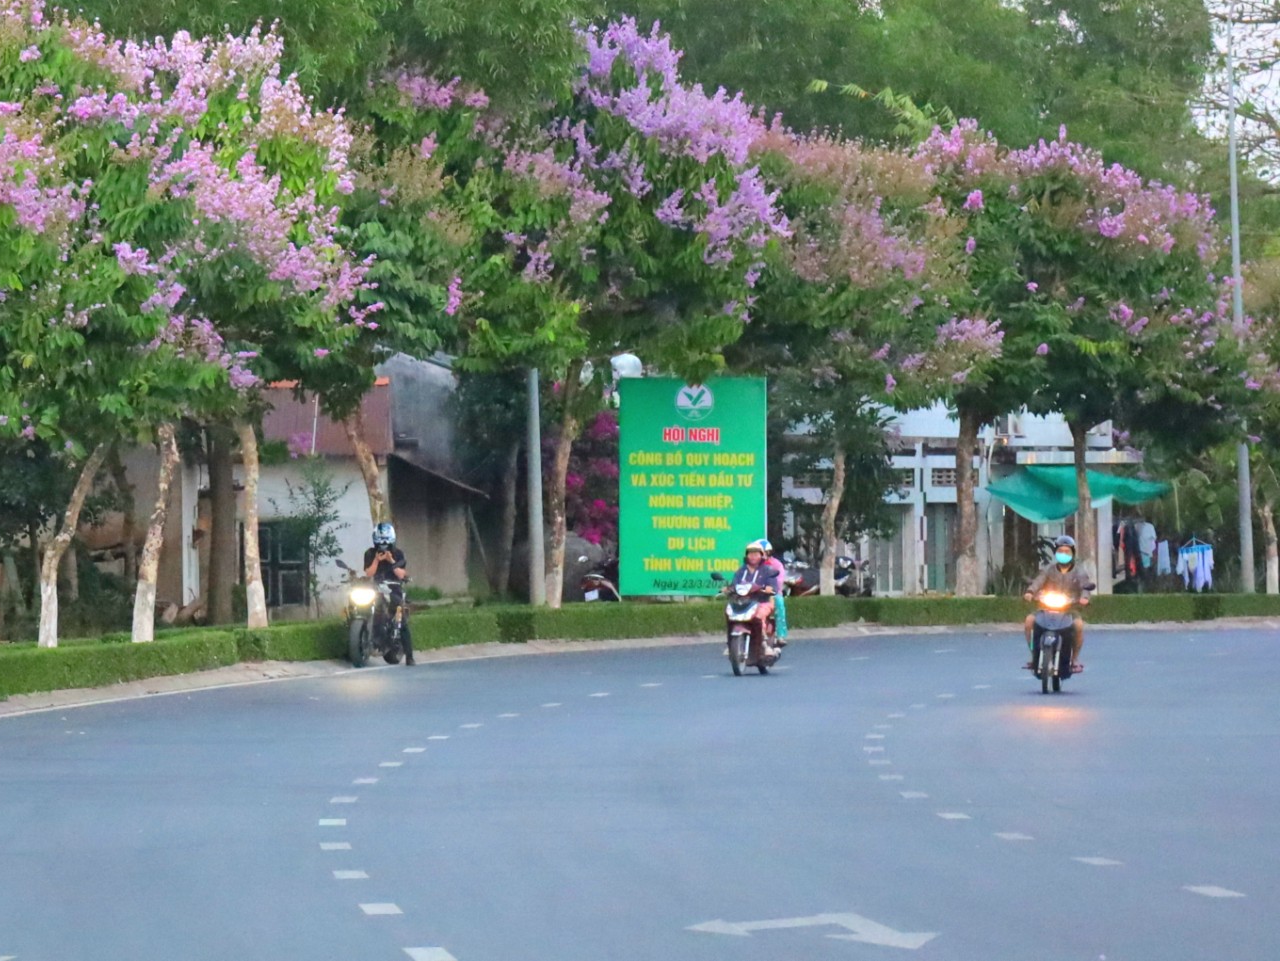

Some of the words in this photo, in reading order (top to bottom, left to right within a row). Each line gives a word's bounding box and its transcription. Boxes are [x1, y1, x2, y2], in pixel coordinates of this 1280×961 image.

[663, 424, 685, 445] HỘI
[688, 427, 720, 445] NGHỊ
[629, 450, 663, 466] CÔNG
[666, 450, 683, 466] BỐ
[686, 453, 710, 466] QUY
[713, 453, 755, 469] HOẠCH
[631, 472, 647, 487] VÀ
[650, 471, 675, 487] XÚC
[679, 470, 706, 487] TIẾN
[709, 470, 734, 487] ĐẦU
[737, 473, 754, 487] TƯ
[649, 493, 684, 508] NÔNG
[652, 515, 700, 529] THƯƠNG
[668, 537, 684, 550] DU
[688, 537, 716, 552] LỊCH
[643, 554, 672, 572] TỈNH
[675, 556, 704, 572] VĨNH
[707, 558, 739, 572] LONG
